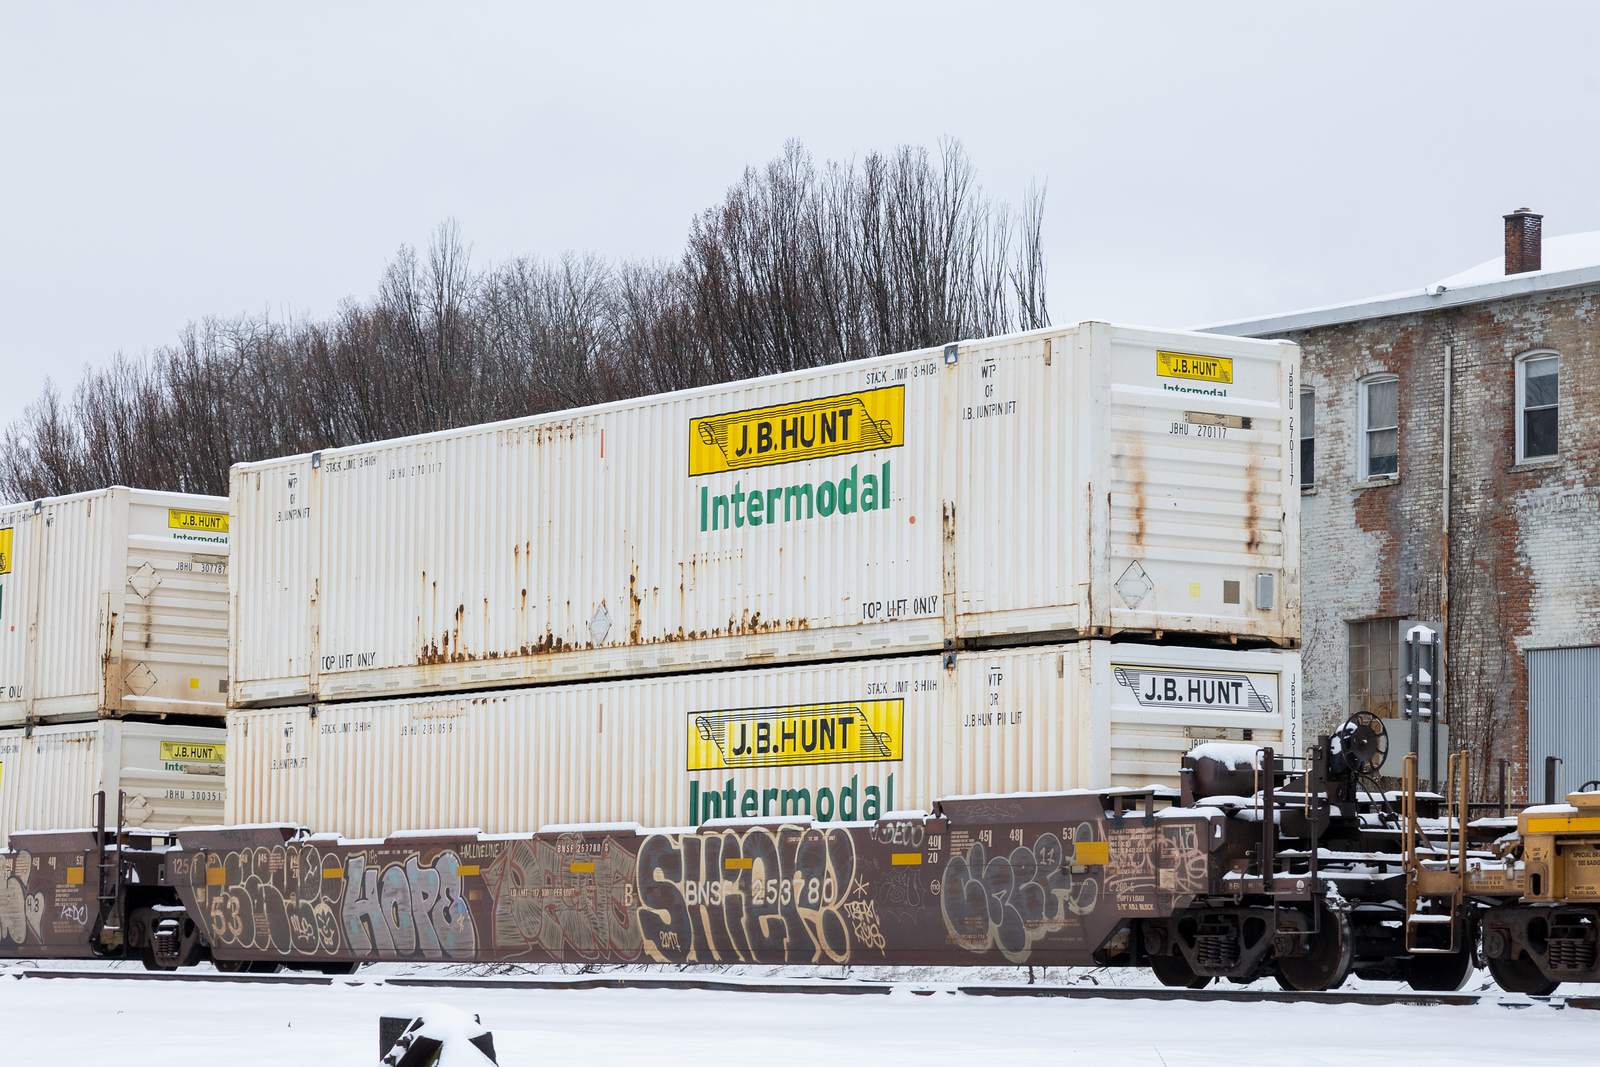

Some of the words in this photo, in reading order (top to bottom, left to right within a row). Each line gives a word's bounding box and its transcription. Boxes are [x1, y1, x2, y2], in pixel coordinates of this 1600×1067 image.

[1168, 422, 1189, 436] JBHU
[1197, 425, 1227, 439] 270117
[700, 459, 891, 533] Intermodal
[176, 561, 193, 572] JBHU
[201, 563, 227, 574] 307787
[862, 601, 882, 620] TOP
[887, 598, 908, 618] LIFT
[913, 595, 938, 616] ONLY
[321, 655, 336, 670] TOP
[338, 653, 354, 669] LIFT
[357, 651, 376, 667] ONLY
[164, 789, 185, 799] JBHU
[191, 791, 221, 801] 300351
[689, 772, 894, 827] Intermodal
[927, 835, 938, 847] 40
[978, 830, 989, 843] 45
[1009, 829, 1020, 842] 48
[1062, 827, 1073, 840] 53
[927, 851, 938, 864] 20
[172, 858, 189, 874] 125
[686, 880, 733, 906] BNSF
[752, 877, 835, 906] 253780
[210, 896, 243, 936] 53
